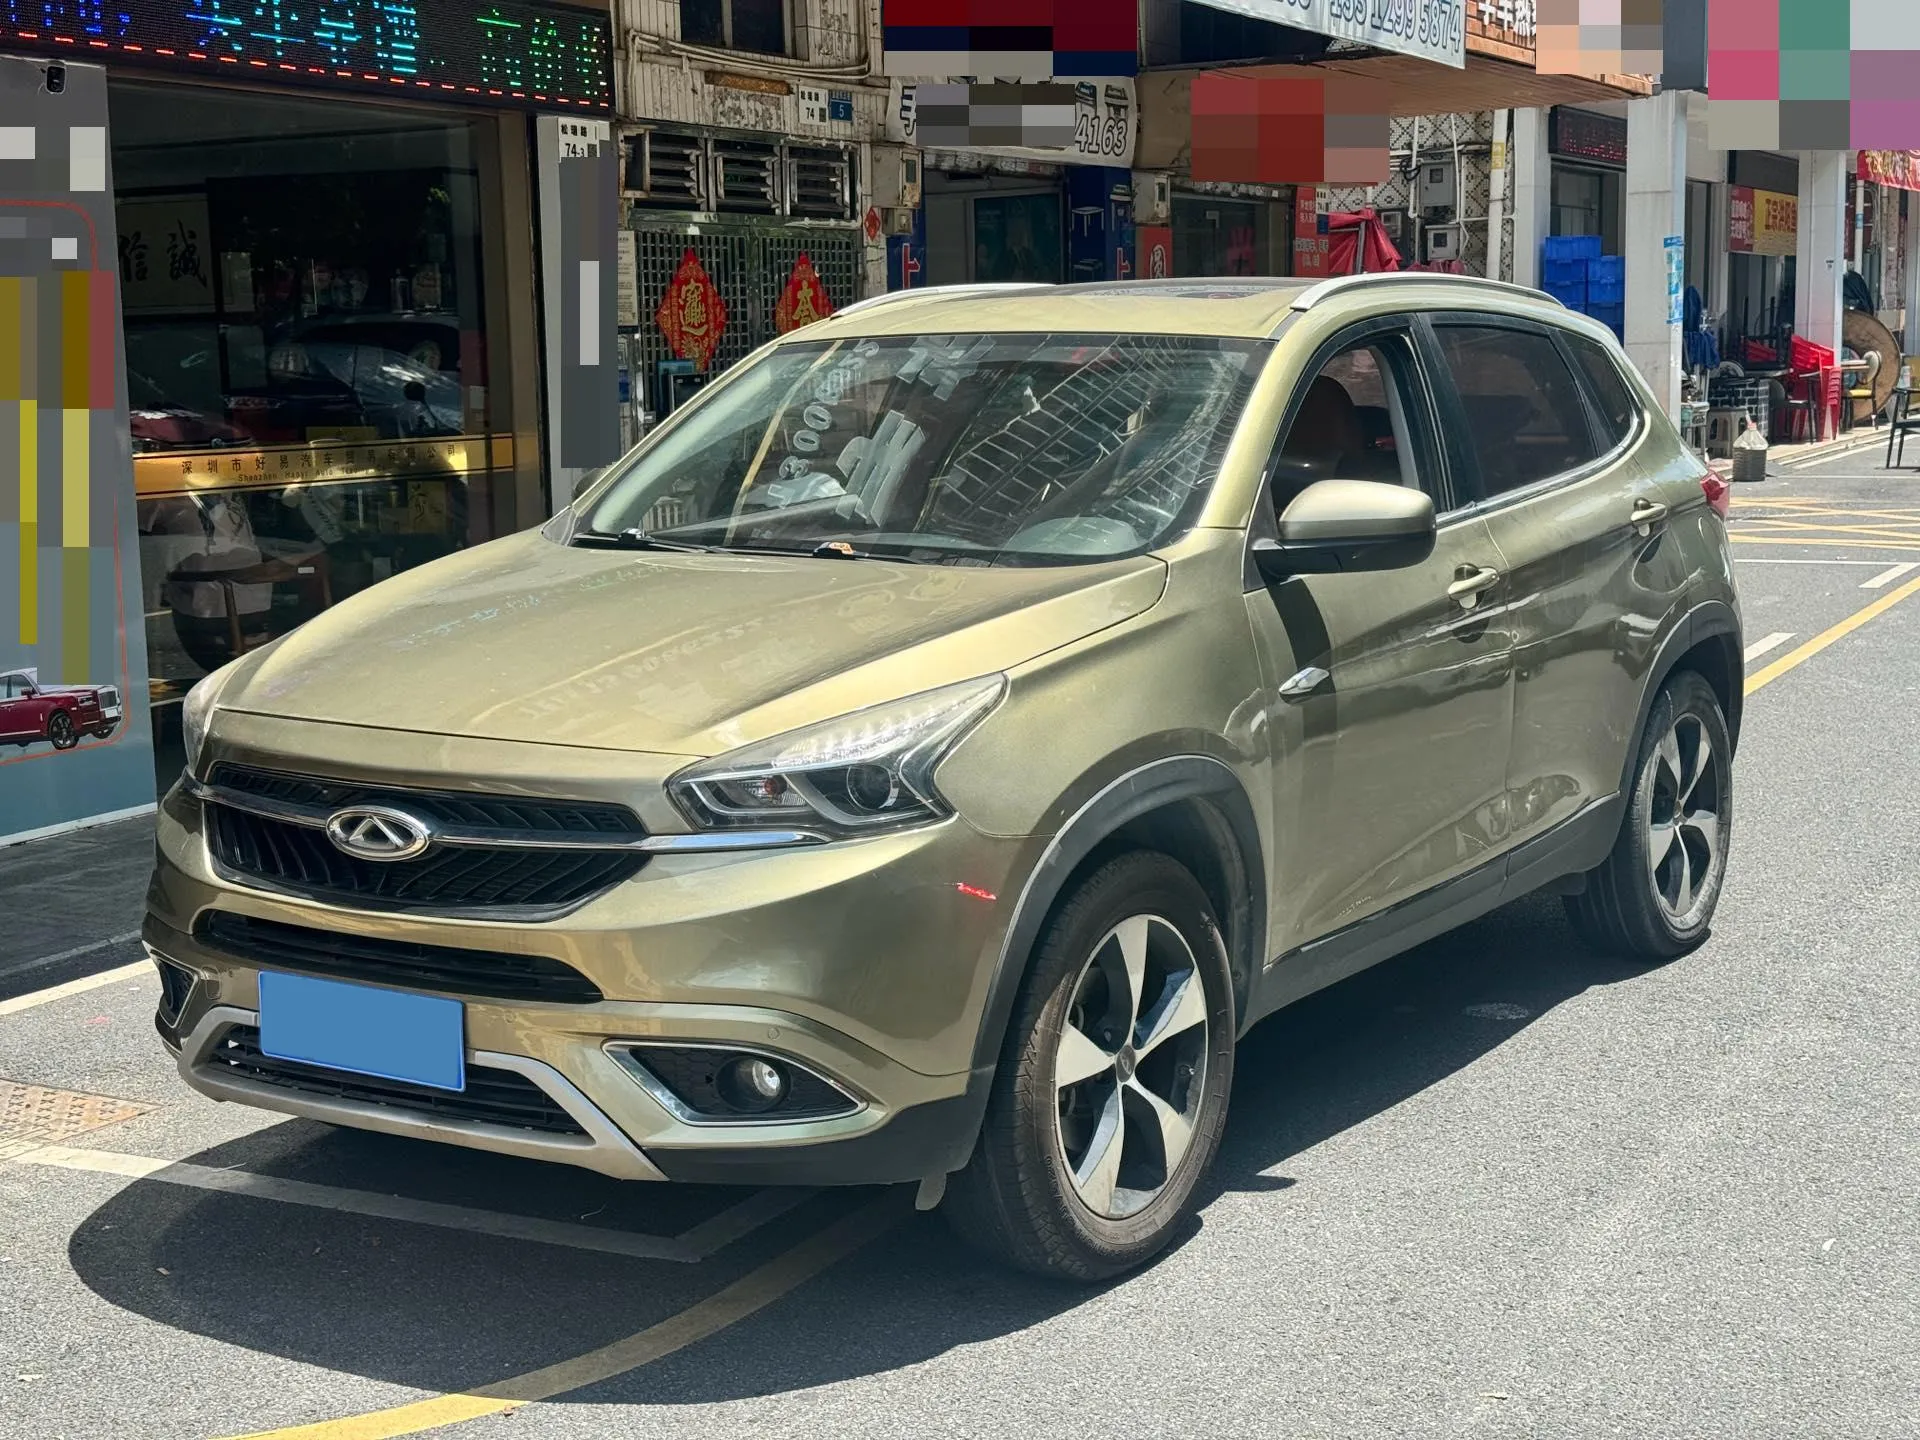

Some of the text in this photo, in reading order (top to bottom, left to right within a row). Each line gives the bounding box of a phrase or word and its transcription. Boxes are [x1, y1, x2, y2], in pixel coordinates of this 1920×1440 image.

[1371, 0, 1415, 39] 1299
[1418, 0, 1462, 53] 5874
[805, 107, 815, 120] 74
[839, 104, 845, 118] 5
[1075, 114, 1128, 157] 4163
[565, 143, 585, 157] 74-3
